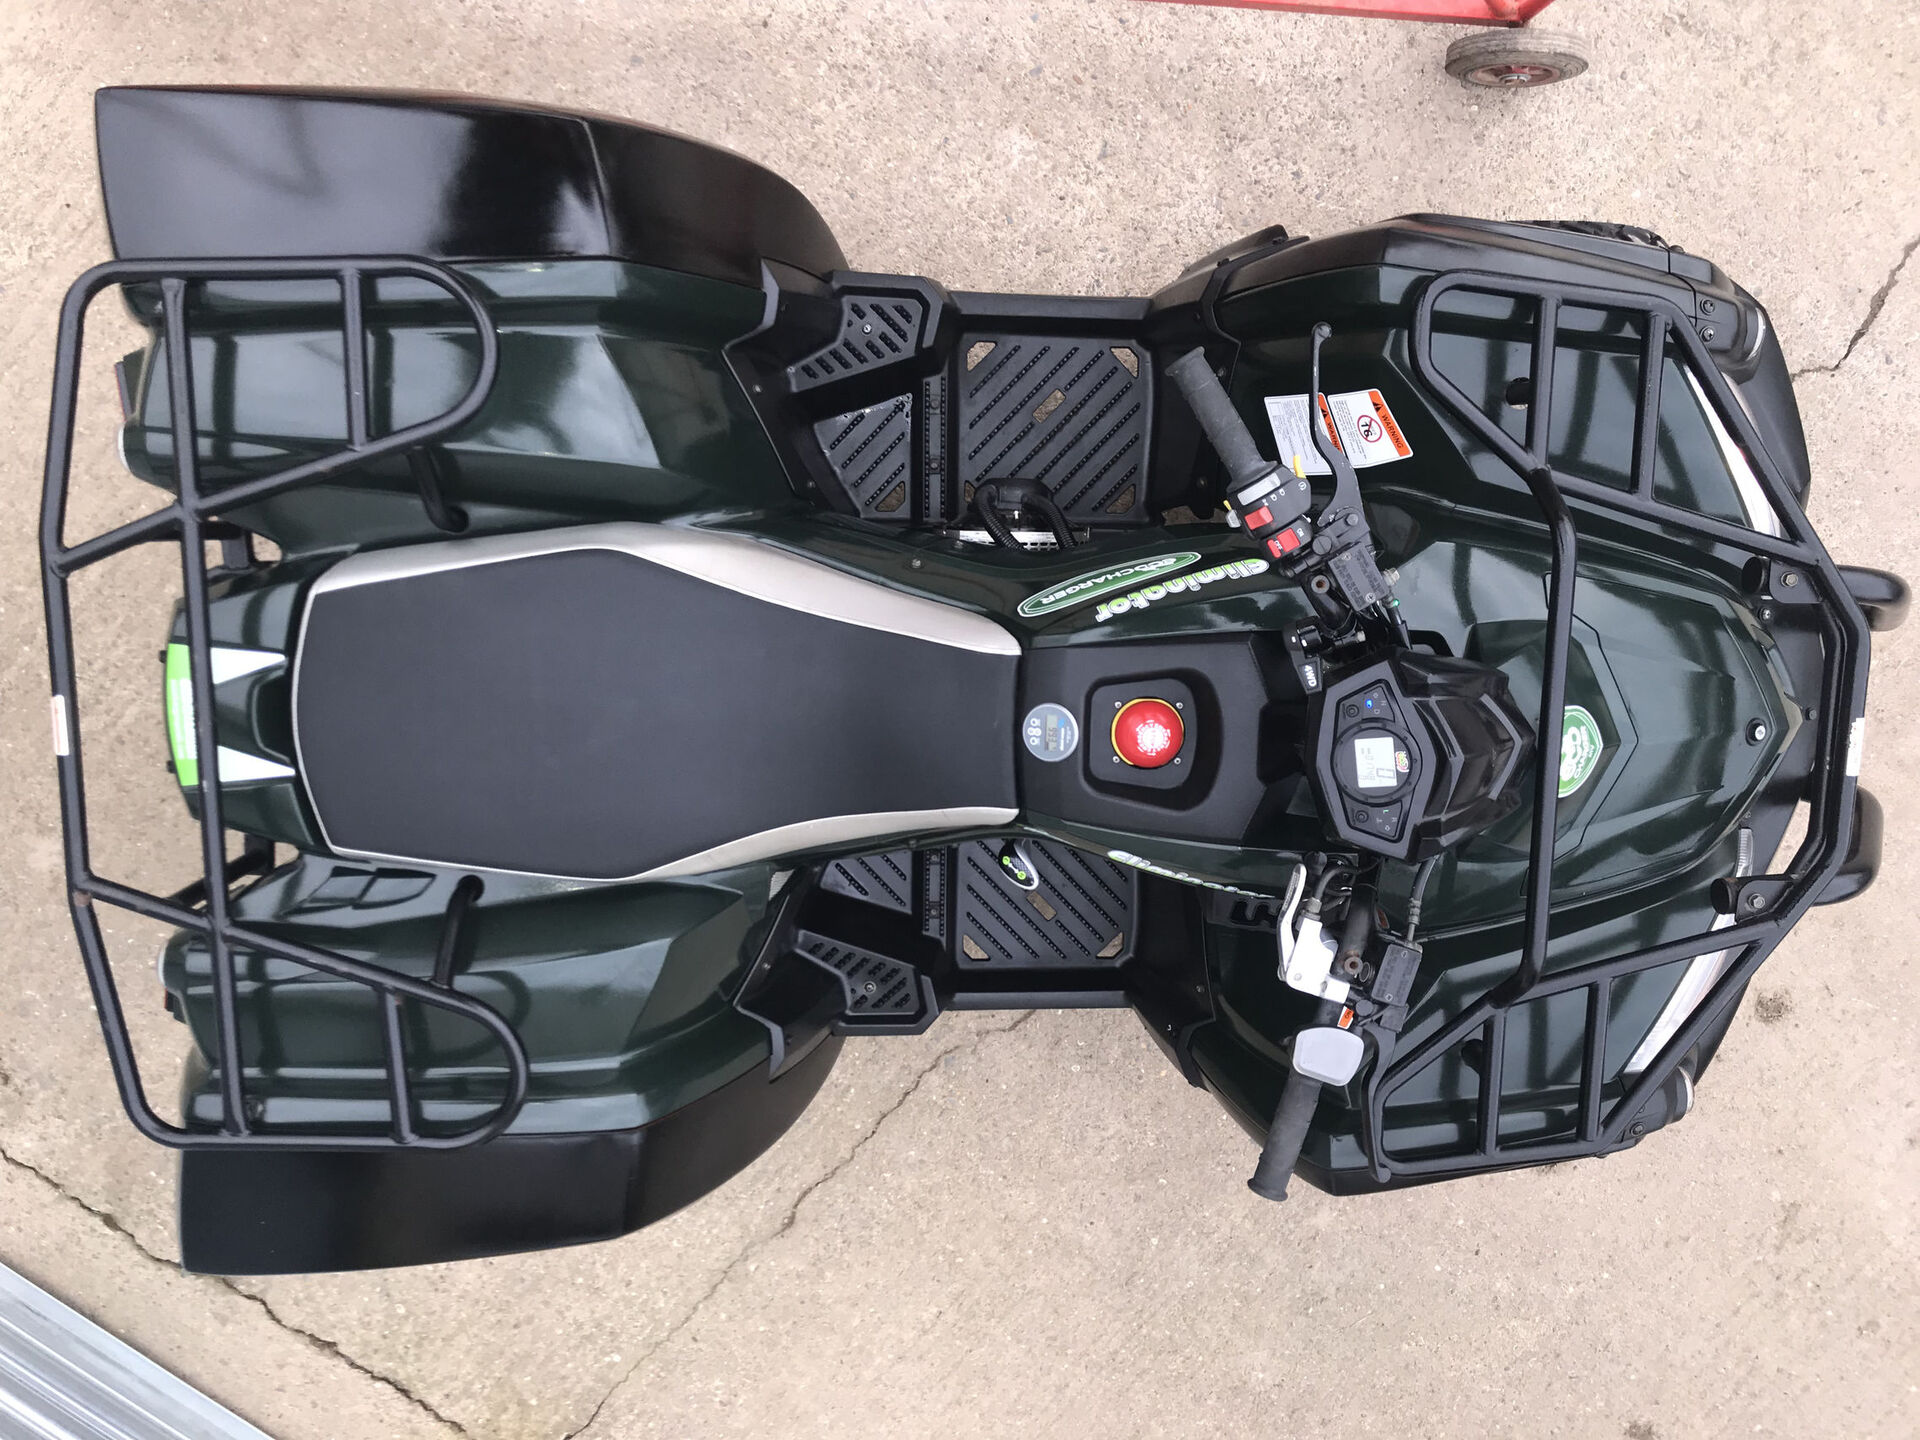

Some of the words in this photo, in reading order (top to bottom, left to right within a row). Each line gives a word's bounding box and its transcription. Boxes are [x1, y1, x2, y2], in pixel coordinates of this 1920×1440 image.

[1361, 422, 1373, 438] 16
[1382, 414, 1404, 449] WARNING
[1304, 664, 1317, 687] 4WD
